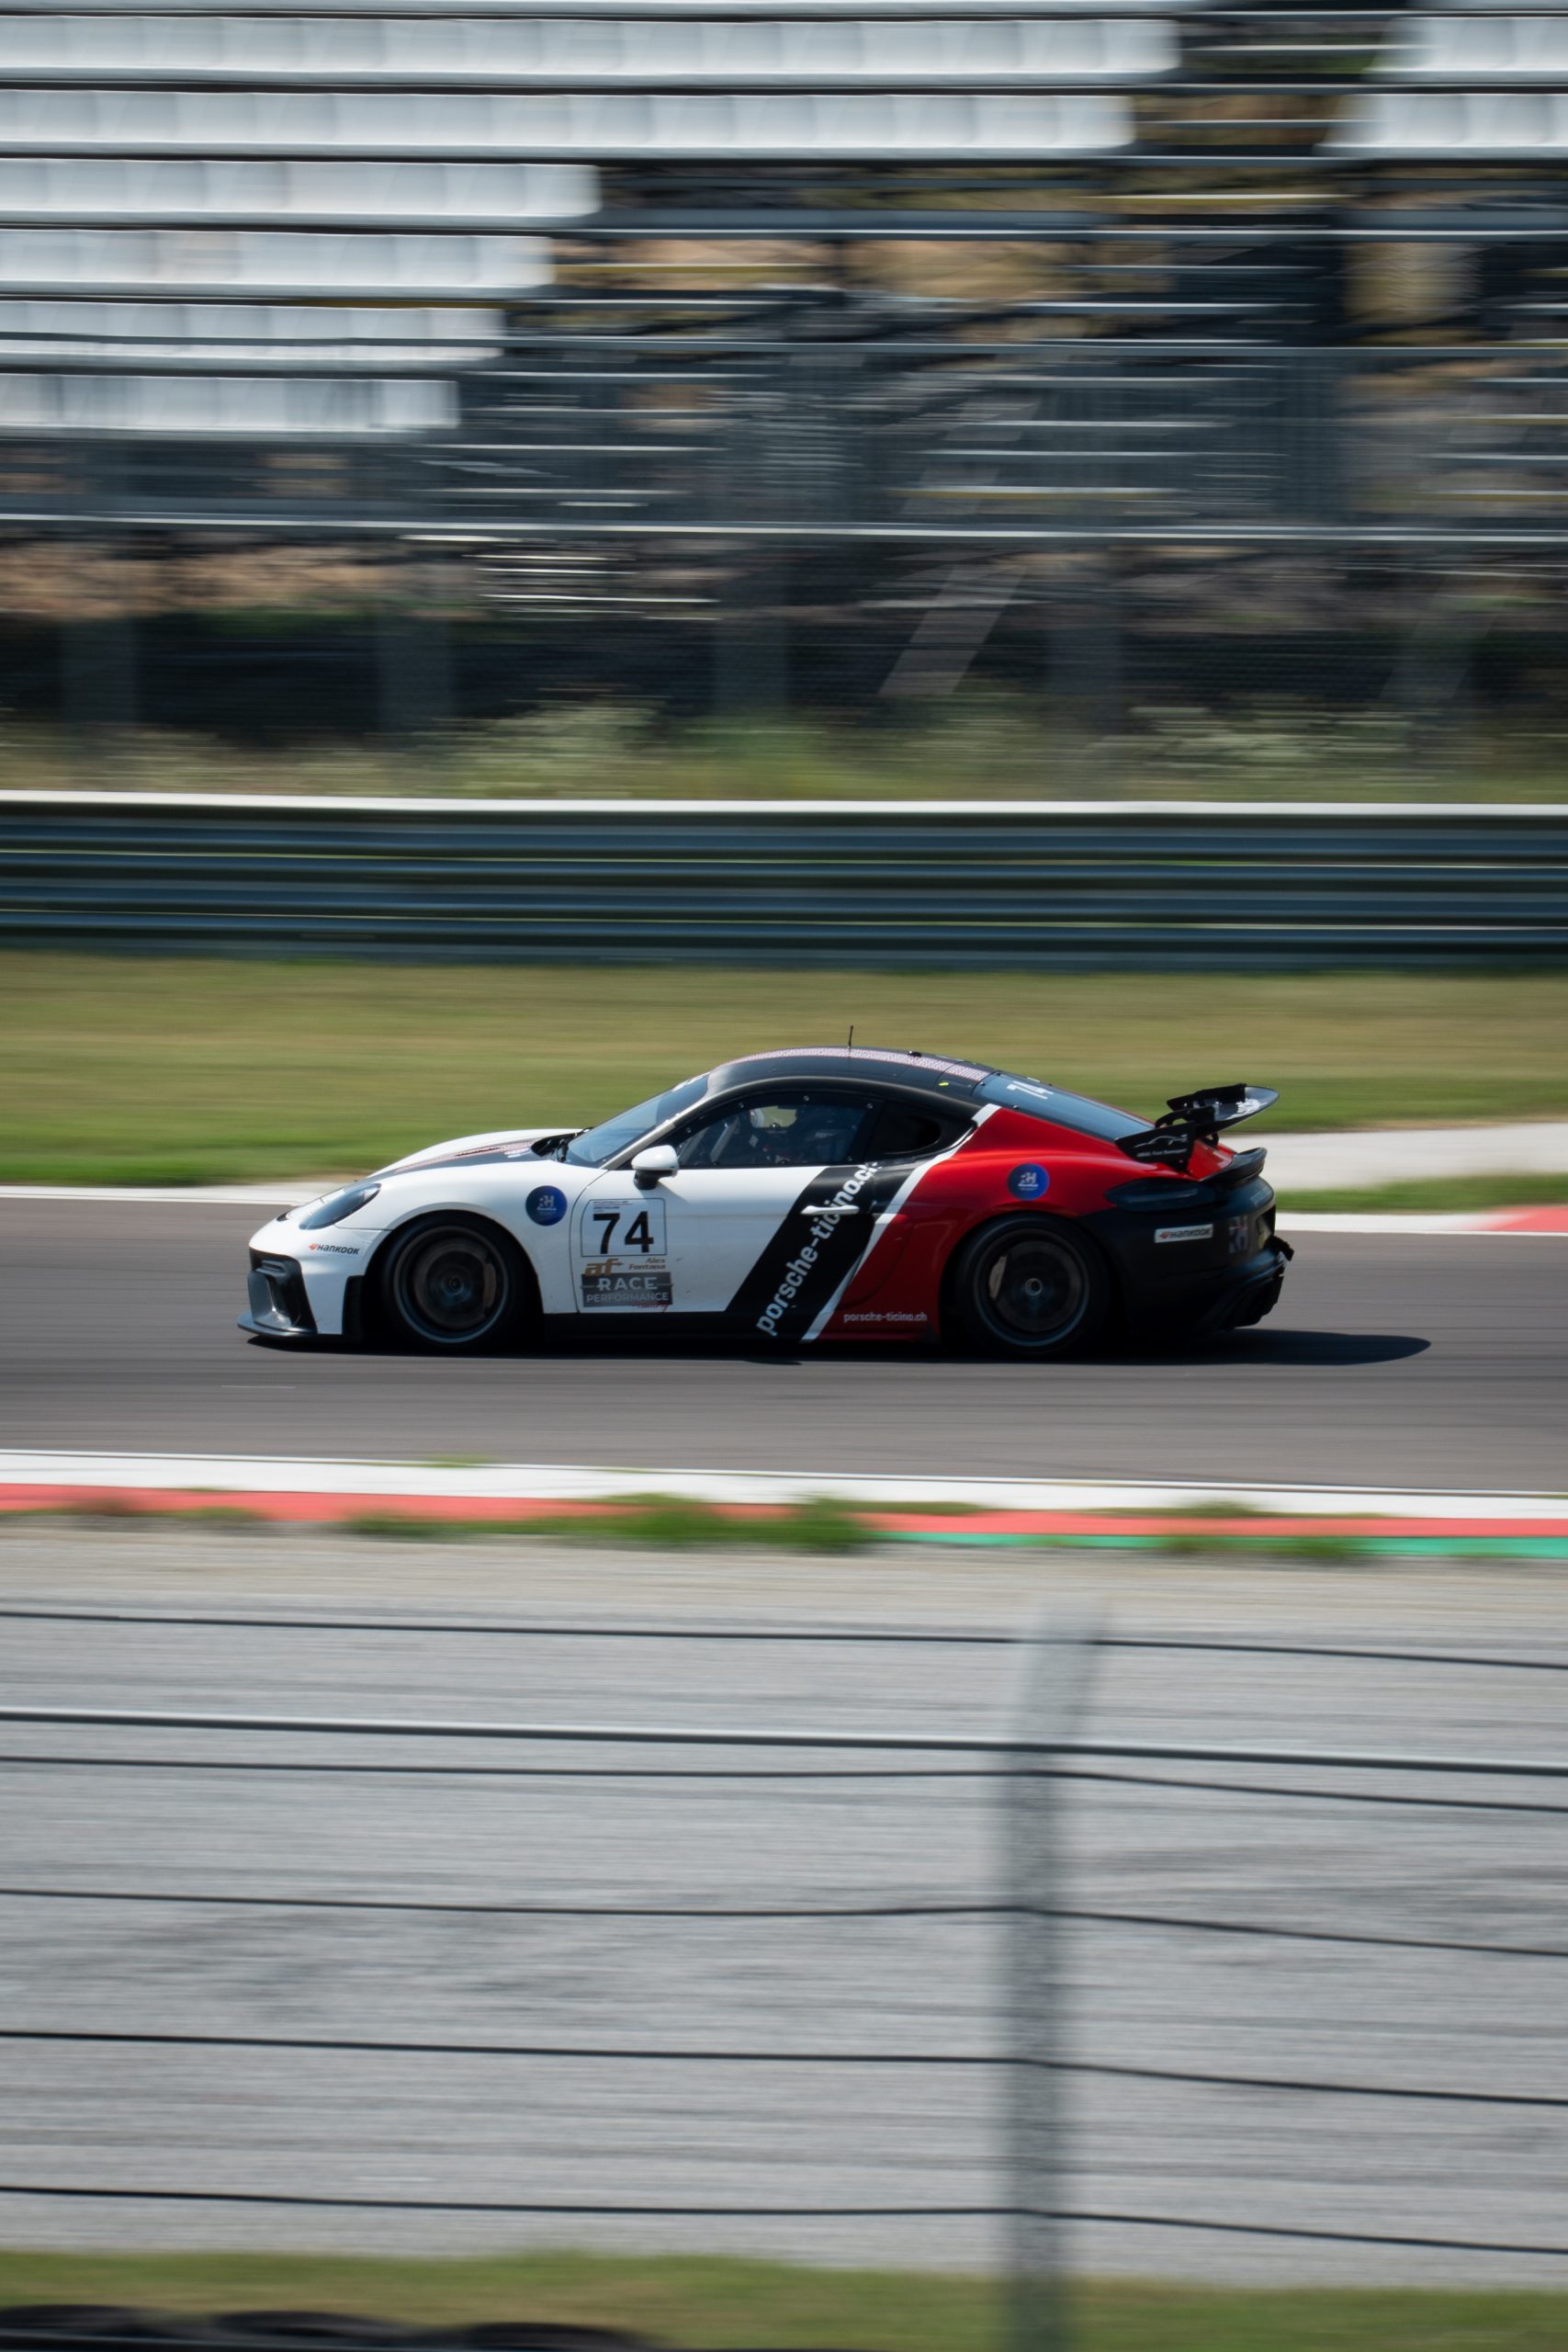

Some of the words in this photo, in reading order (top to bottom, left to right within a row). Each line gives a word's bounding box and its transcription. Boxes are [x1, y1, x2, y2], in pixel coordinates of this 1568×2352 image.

[592, 1211, 654, 1255] 74
[596, 1276, 659, 1292] RACE
[586, 1292, 670, 1303] PERFORMANCE
[843, 1312, 928, 1323] porsche-ticino.ch
